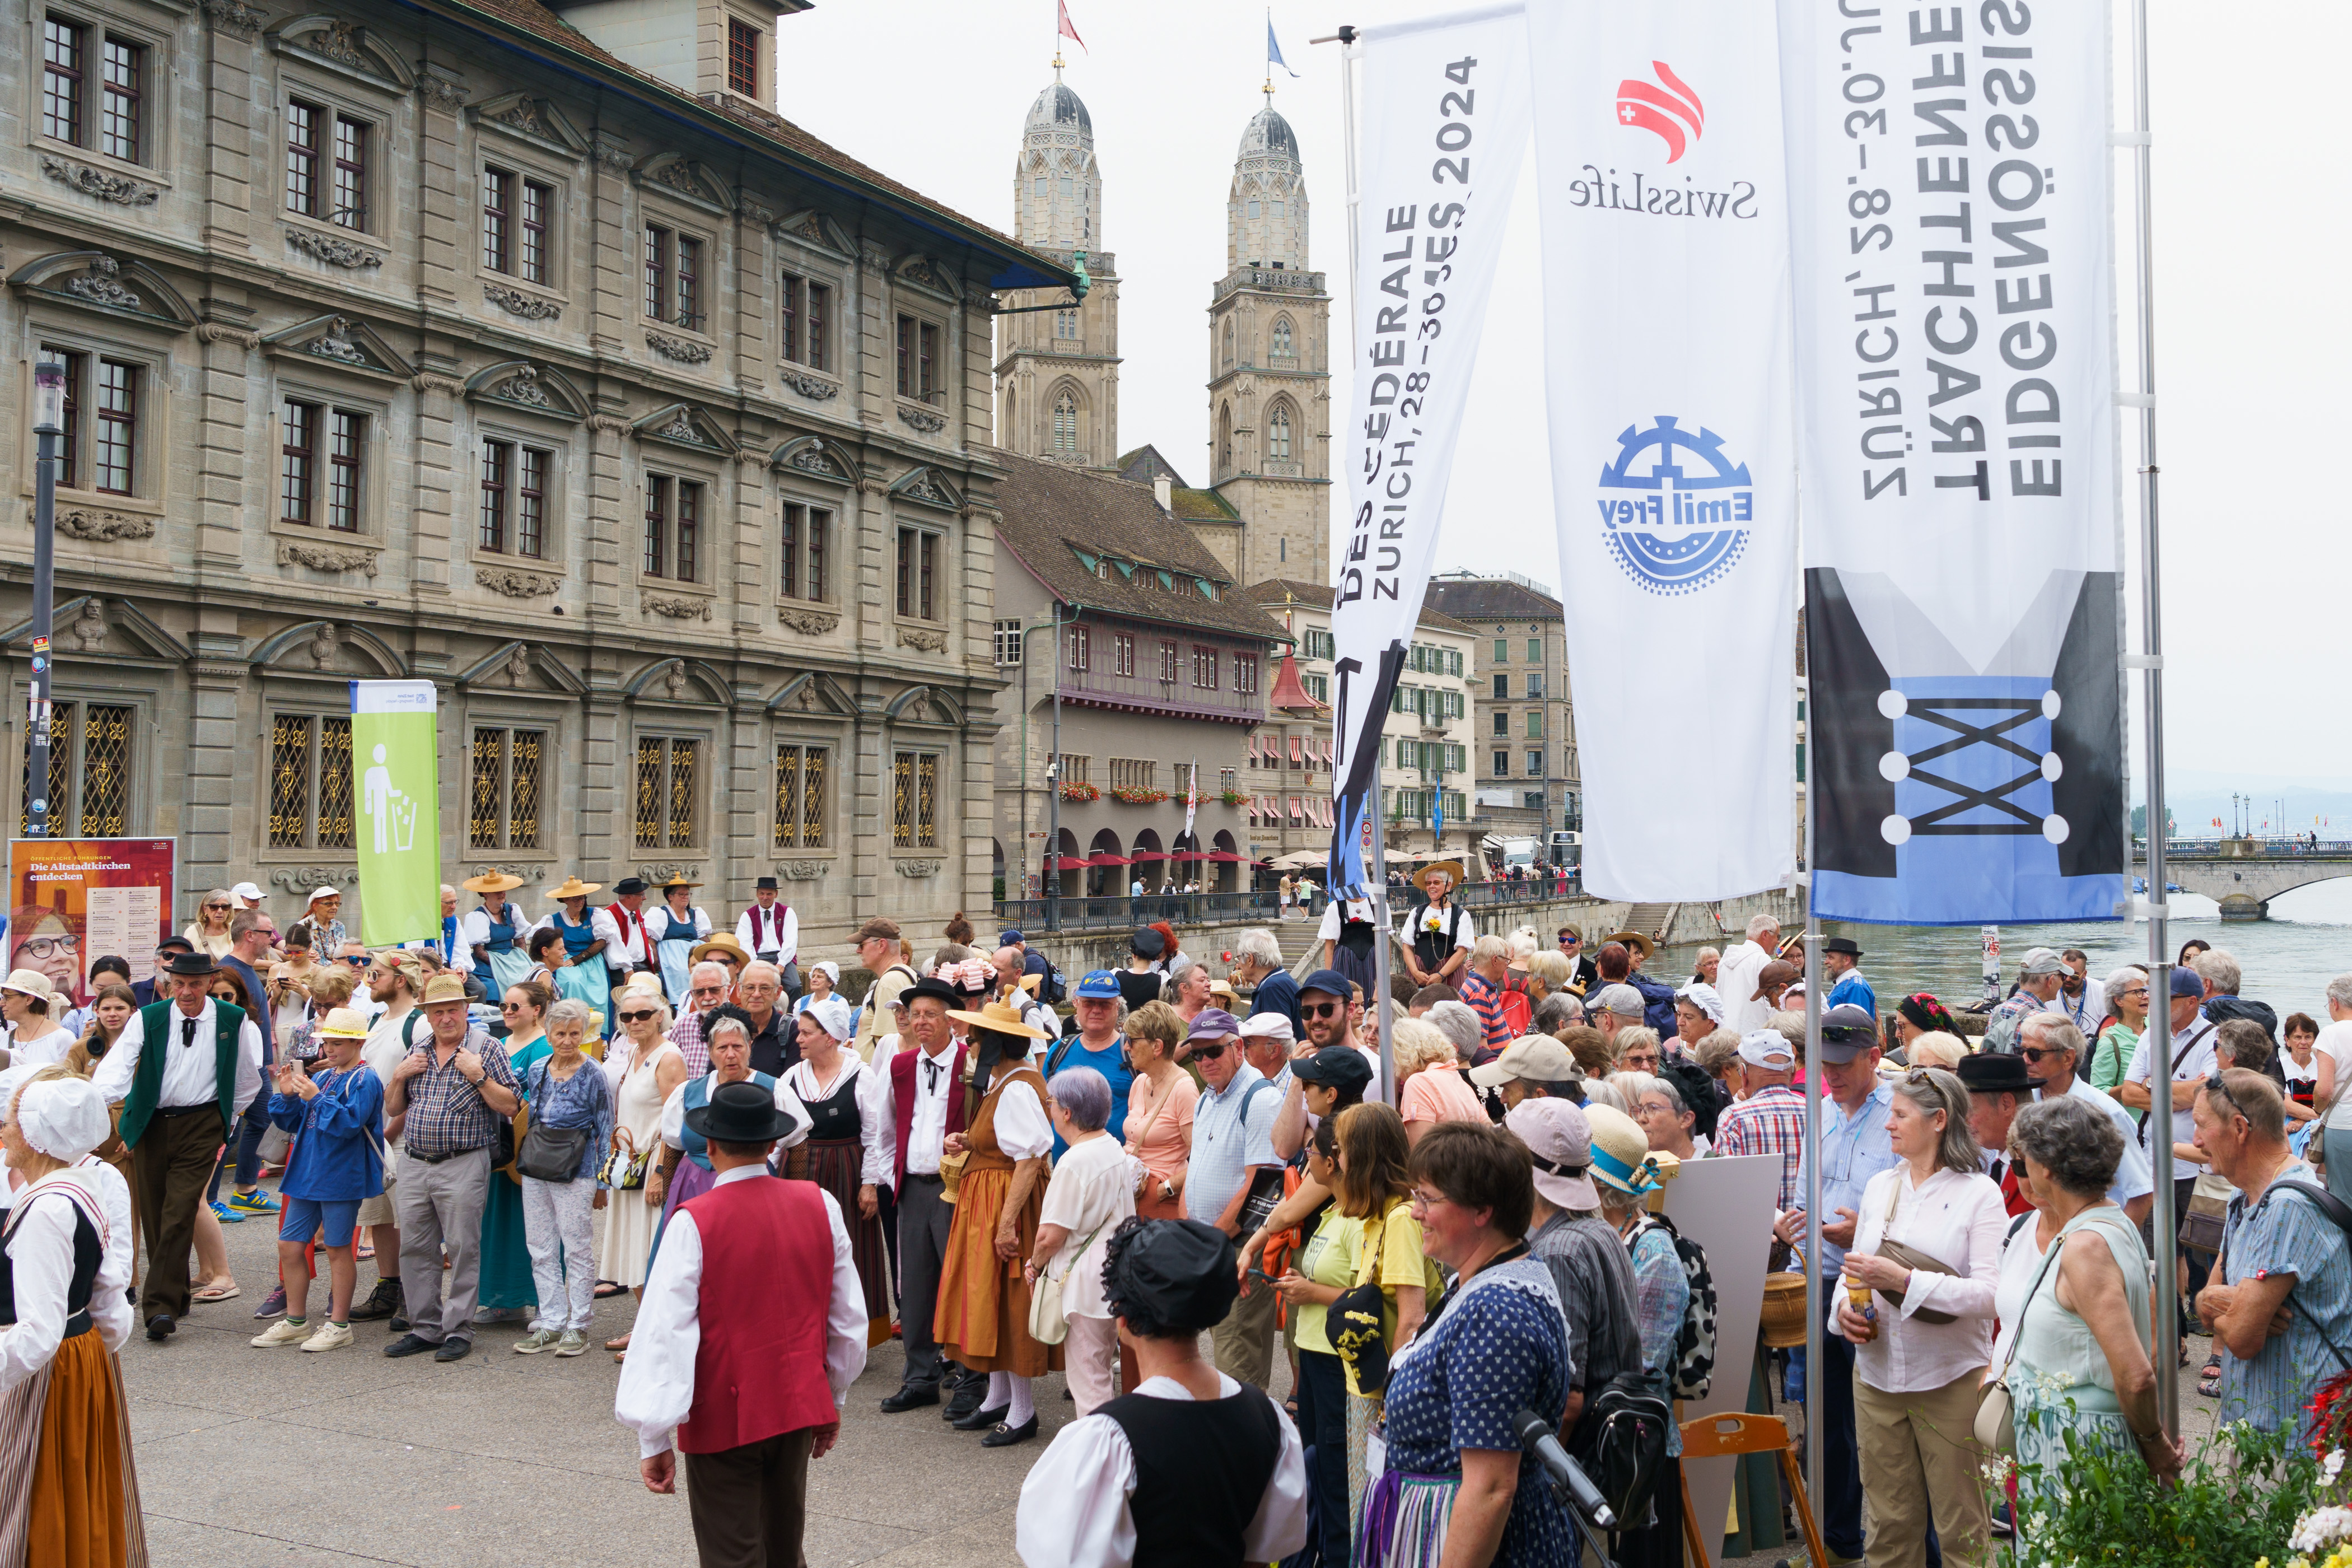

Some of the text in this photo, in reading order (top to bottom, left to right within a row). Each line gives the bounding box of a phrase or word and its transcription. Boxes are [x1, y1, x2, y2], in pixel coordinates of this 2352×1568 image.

[1433, 55, 1478, 184] 2024
[1373, 427, 1422, 600] ZURICH,
[50, 862, 131, 871] Altstadtkirchen
[1345, 1310, 1379, 1326] dragon
